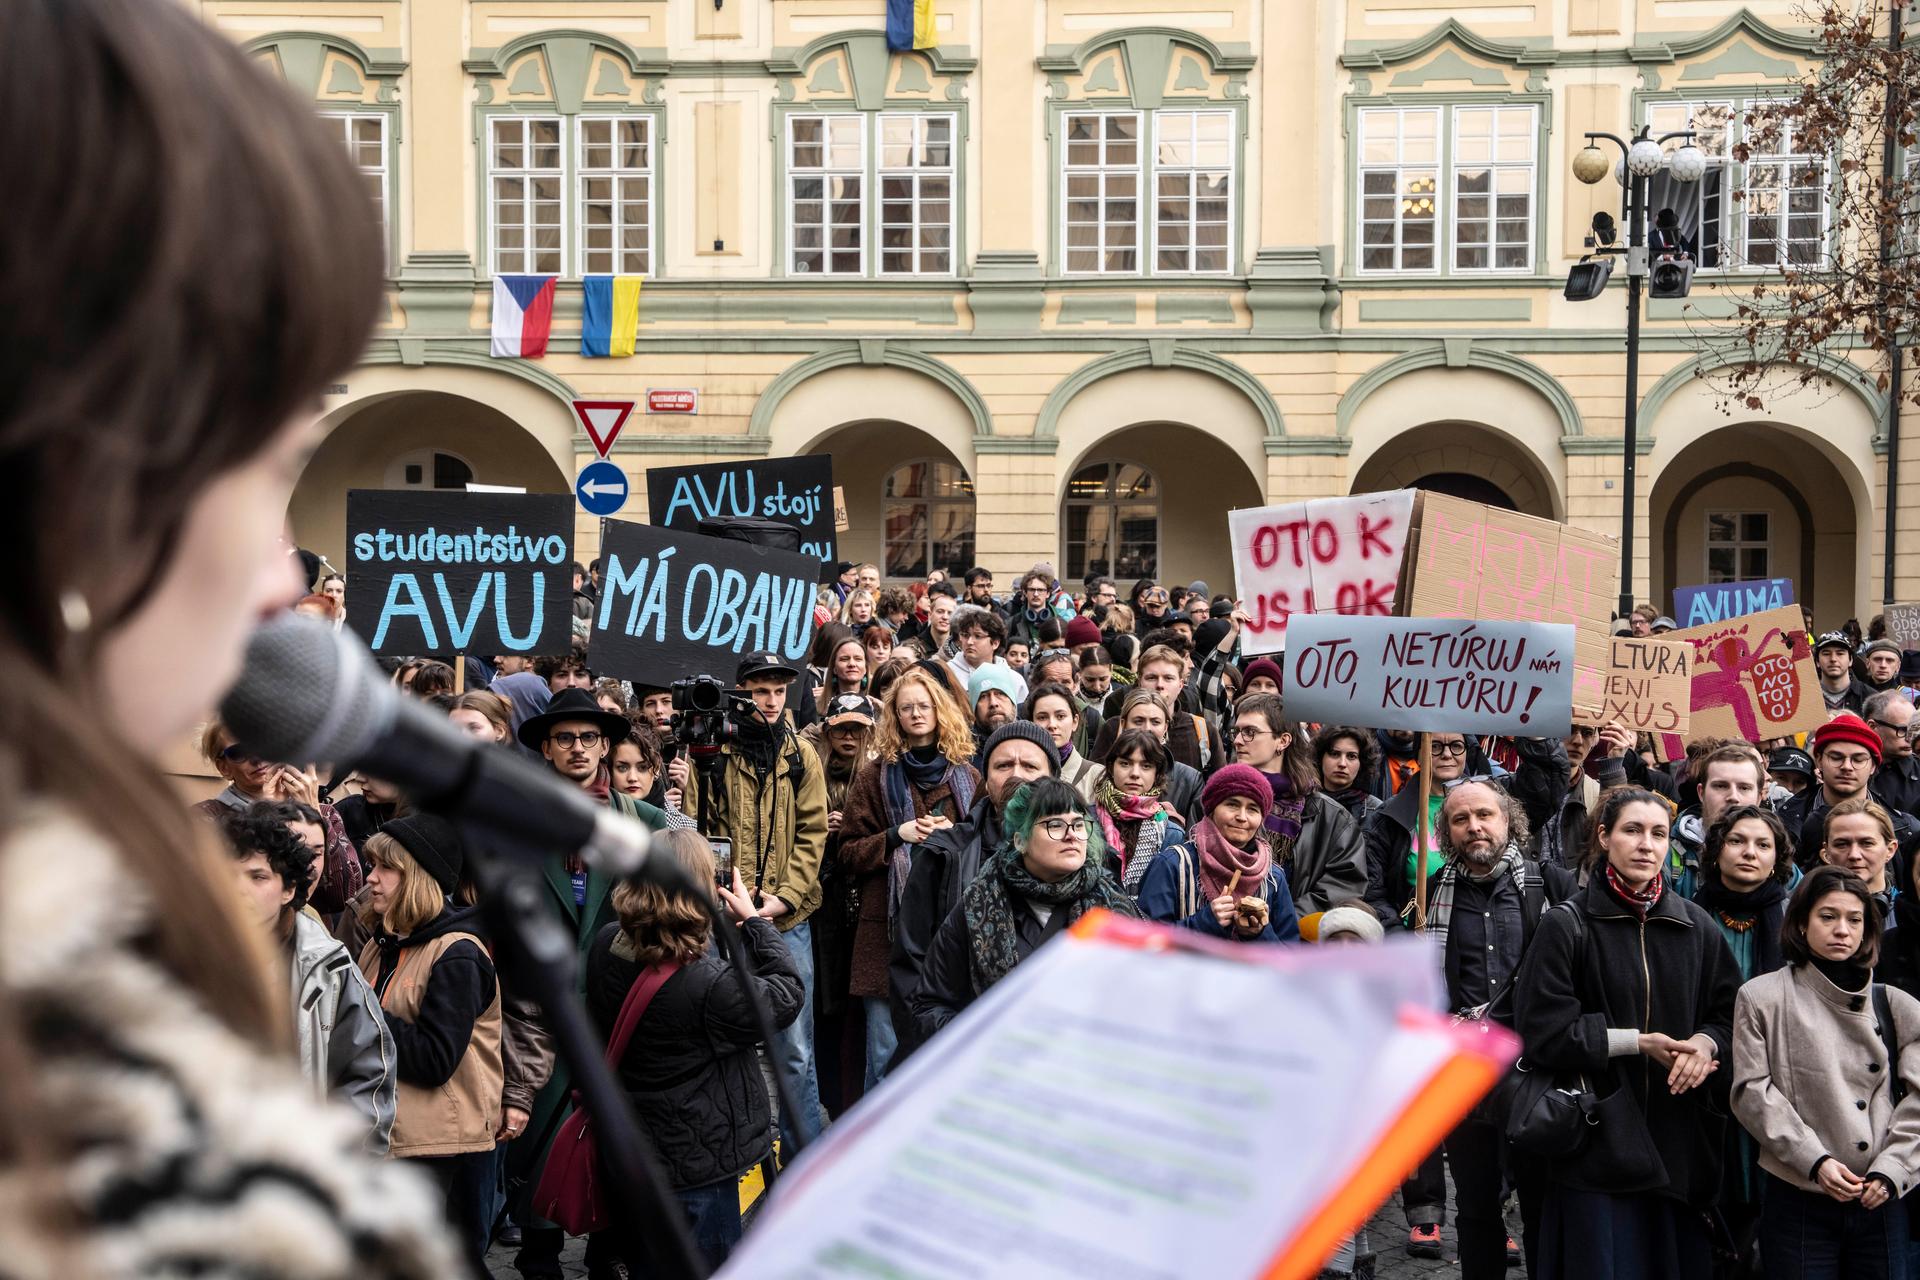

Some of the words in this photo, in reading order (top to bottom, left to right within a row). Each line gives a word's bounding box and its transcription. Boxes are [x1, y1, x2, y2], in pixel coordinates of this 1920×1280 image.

[664, 469, 756, 527] AVU
[762, 481, 822, 526] stojí
[354, 526, 567, 564] studentstvo
[1252, 519, 1338, 571] OTO
[371, 571, 546, 650] AVU
[598, 546, 677, 643] MÁ
[682, 563, 818, 660] OBAVU
[1687, 589, 1743, 628] AVU
[1296, 638, 1360, 700] OTO,
[1382, 624, 1527, 673] NETÚRUJ
[1529, 649, 1561, 674] NÁM
[1612, 642, 1687, 677] LTURA
[1753, 655, 1794, 676] OTO,
[1381, 671, 1543, 724] KULTŮRU!
[1758, 684, 1794, 705] TOT
[1762, 671, 1791, 690] NO
[1771, 699, 1792, 718] O!
